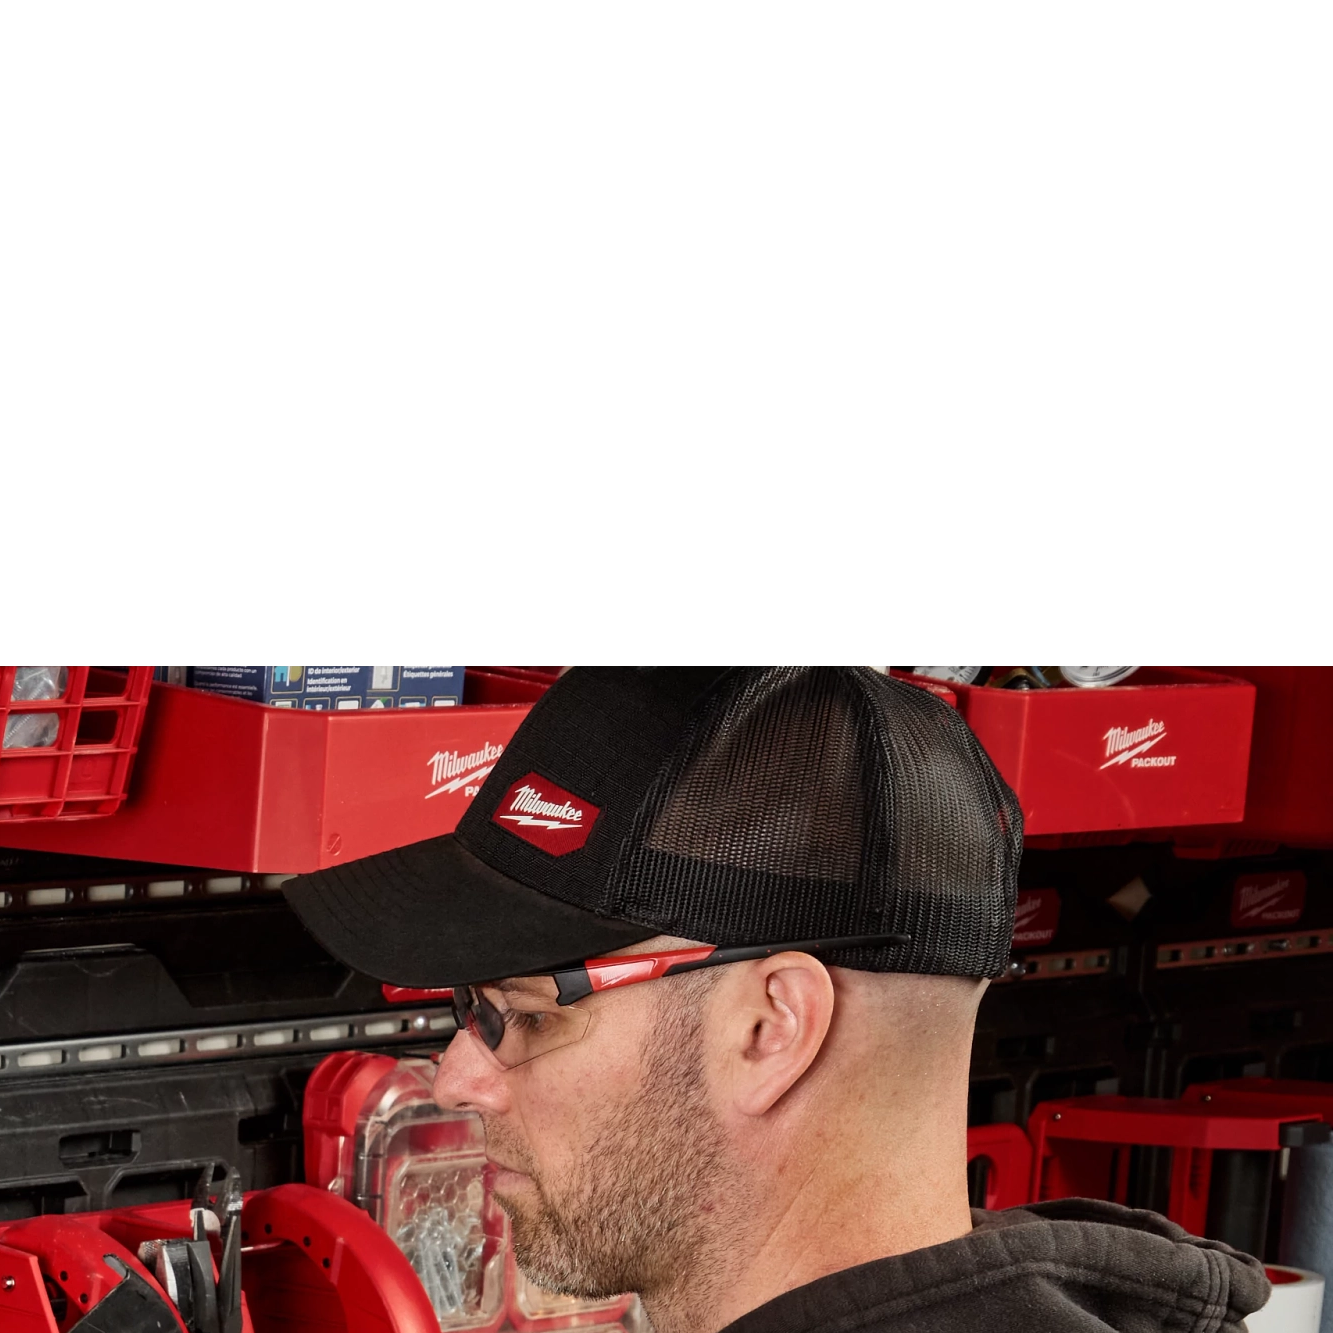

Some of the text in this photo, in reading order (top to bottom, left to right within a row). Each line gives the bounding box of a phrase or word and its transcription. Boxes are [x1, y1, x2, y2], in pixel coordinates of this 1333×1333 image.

[1103, 719, 1165, 757] Milwaukee
[427, 741, 504, 785] Milwaukee
[1131, 755, 1177, 769] PACKOUT
[515, 785, 582, 821] Milwaukee
